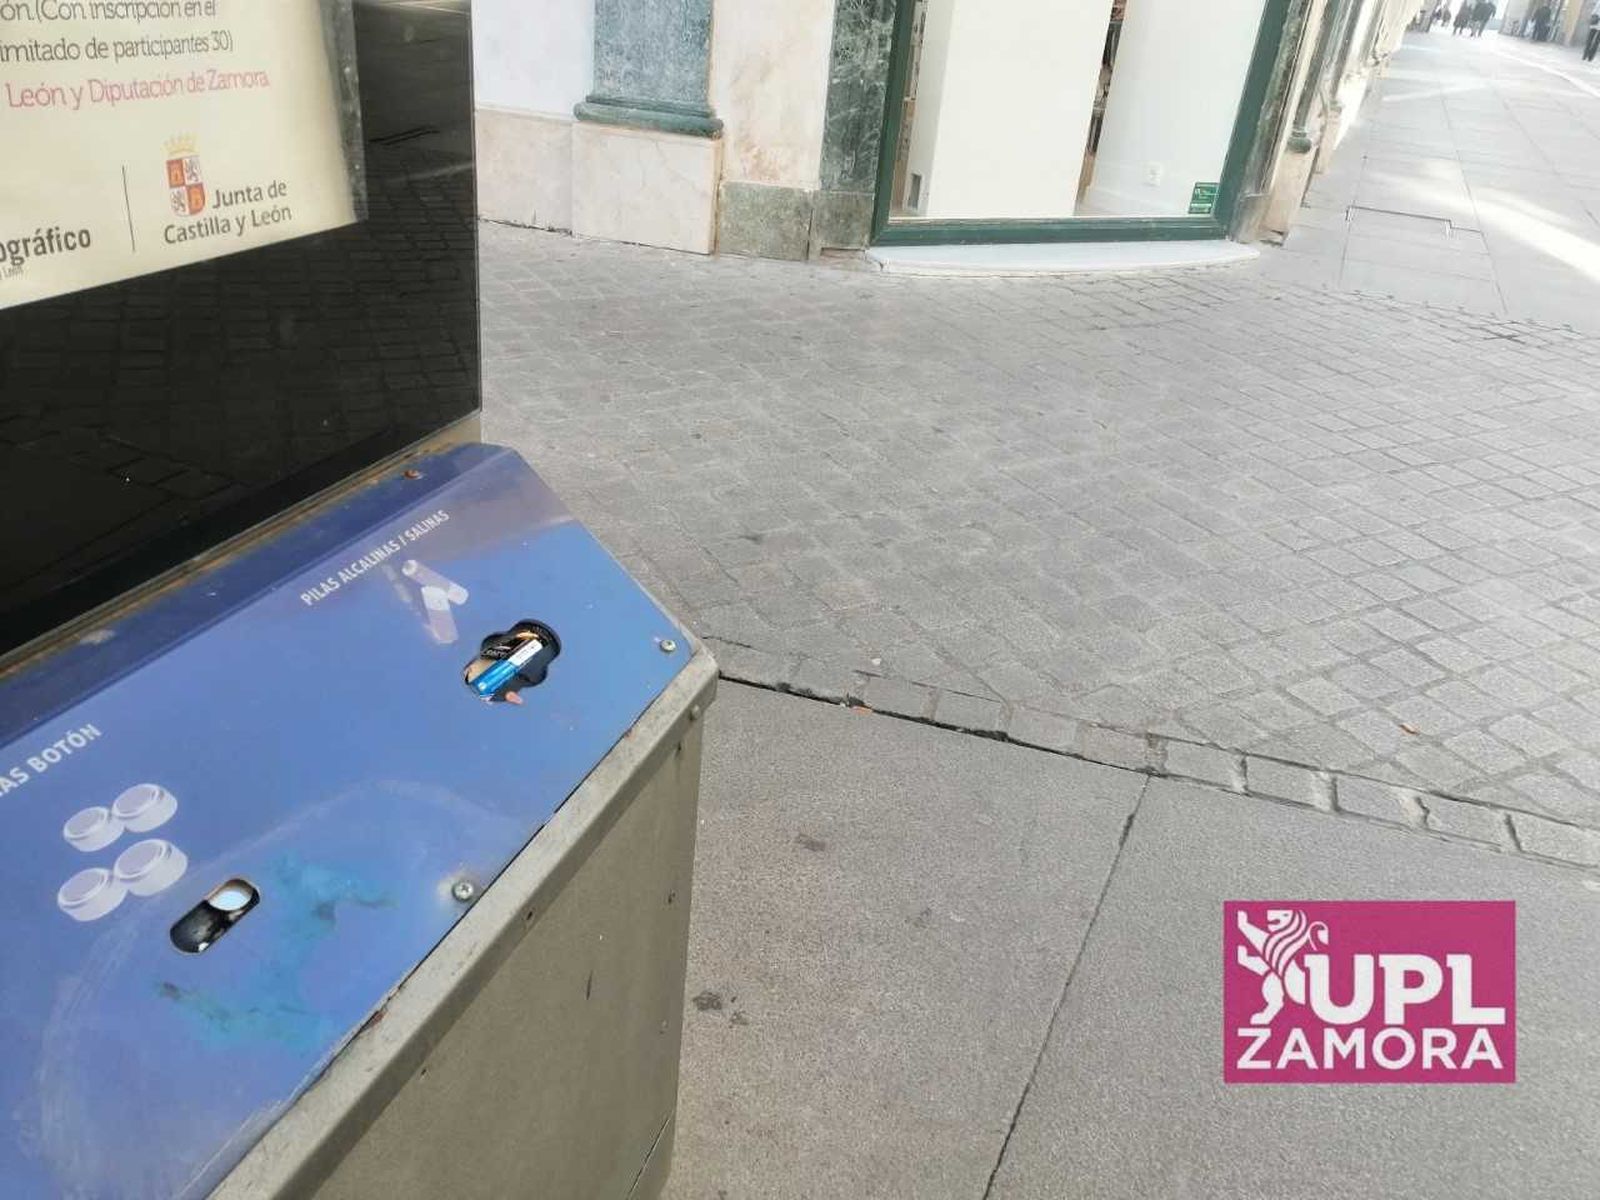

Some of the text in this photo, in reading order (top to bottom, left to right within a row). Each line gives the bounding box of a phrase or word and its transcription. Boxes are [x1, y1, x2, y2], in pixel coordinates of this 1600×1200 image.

[184, 1, 202, 17] en
[85, 37, 109, 60] de
[112, 34, 210, 63] participantes
[210, 29, 234, 52] 30)
[5, 68, 270, 110] León y Diputación de Zamora
[212, 180, 287, 209] Junta de
[164, 205, 292, 244] Castilla y León
[300, 509, 450, 606] PILAS ALCALINAS / SALINAS
[0, 724, 102, 797] AS BOTÓN
